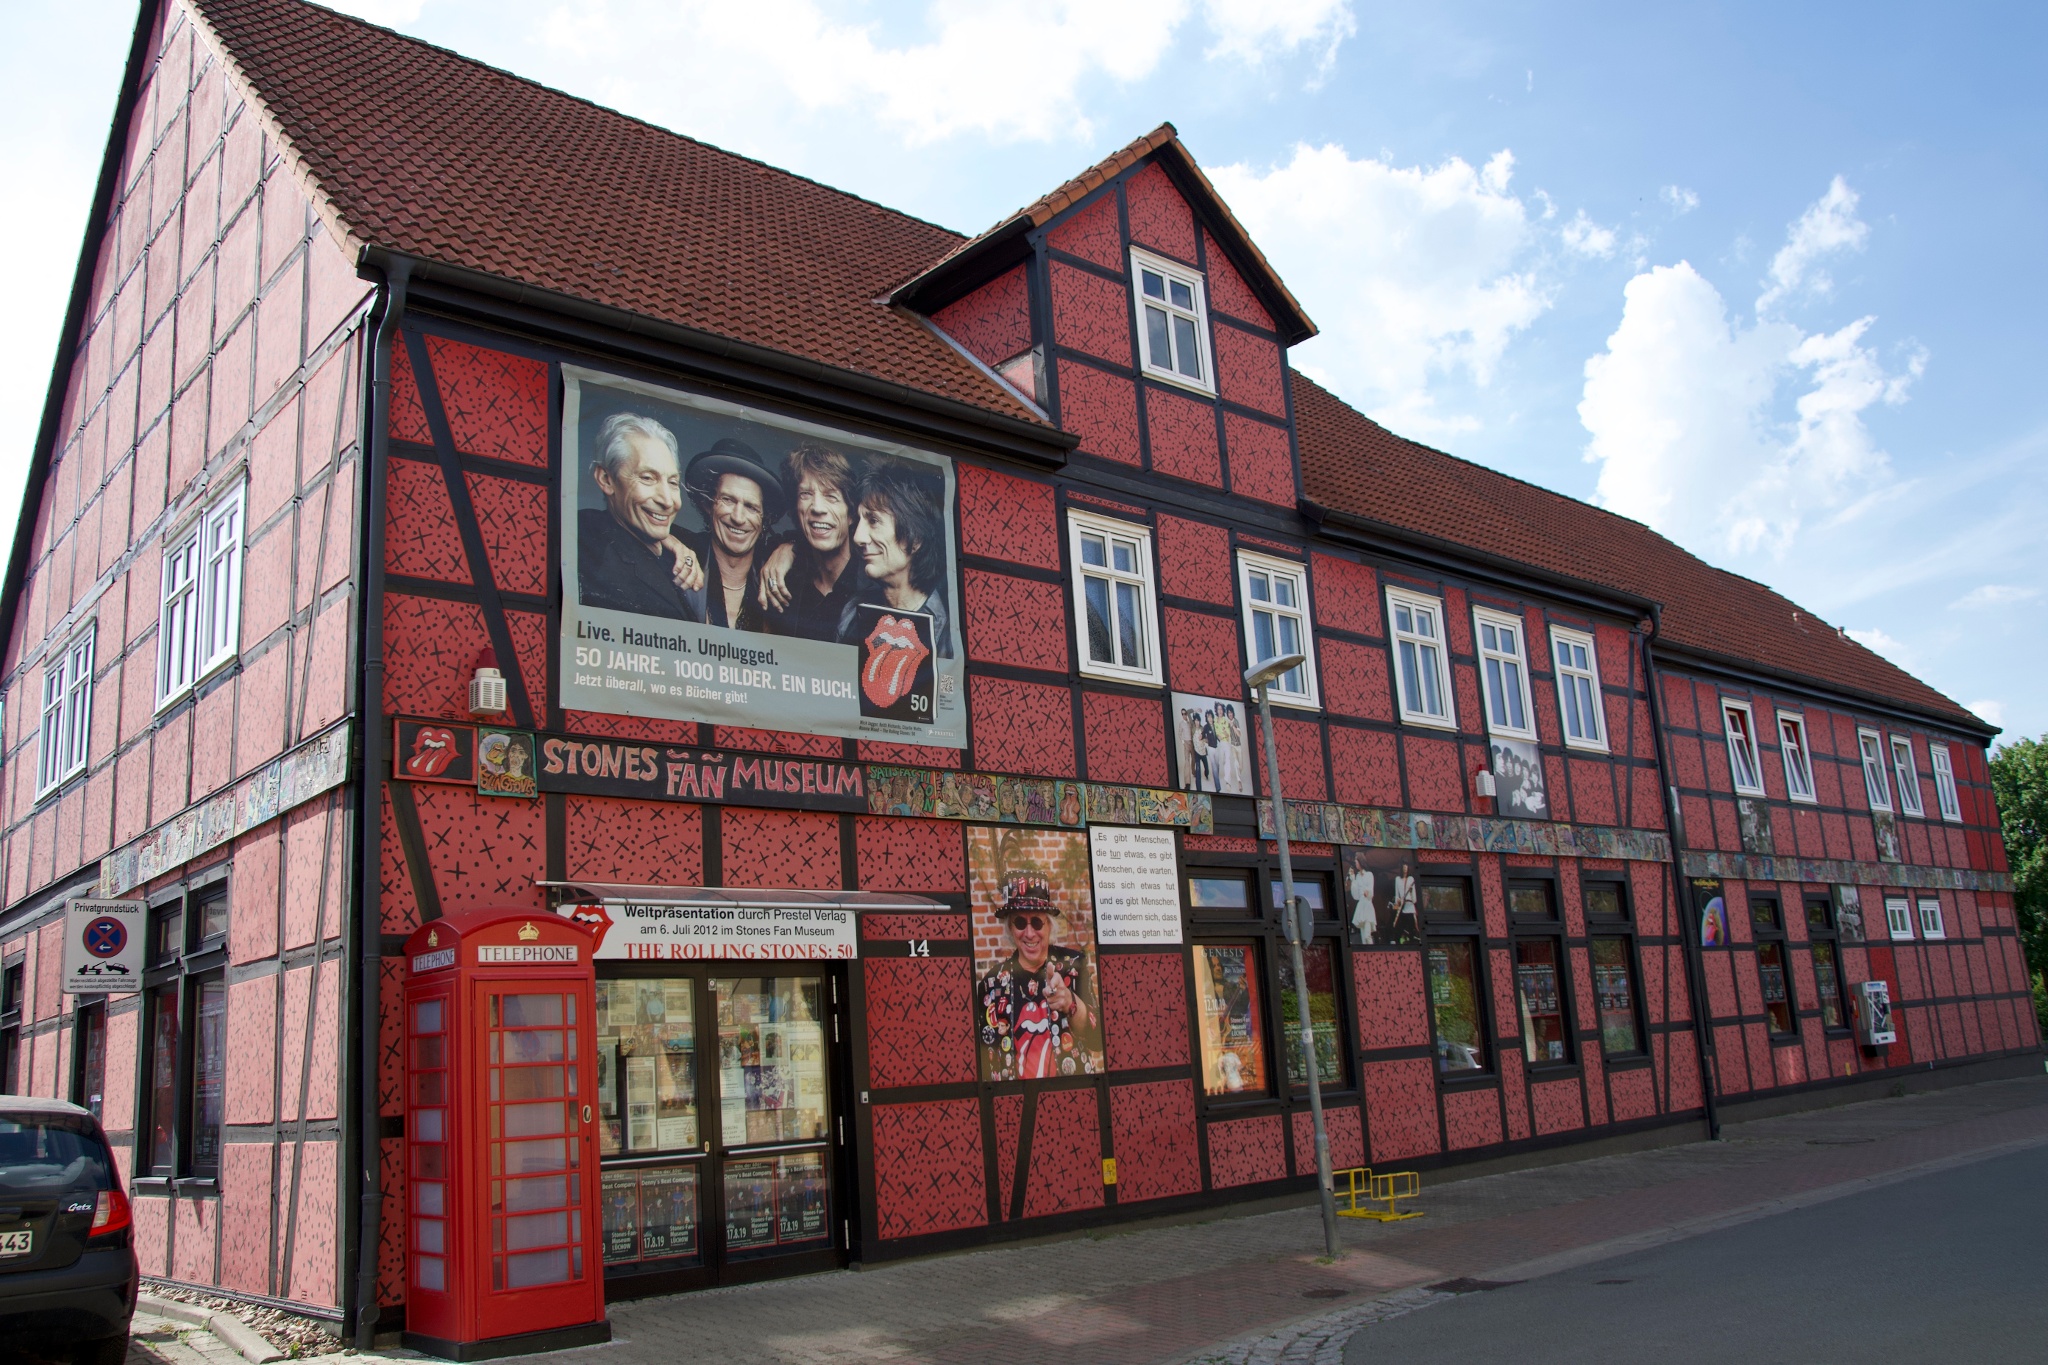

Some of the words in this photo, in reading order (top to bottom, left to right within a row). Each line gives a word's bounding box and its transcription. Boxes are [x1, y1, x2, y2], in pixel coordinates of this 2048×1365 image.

[577, 620, 615, 642] Live.
[622, 627, 691, 653] Hautnah.
[698, 638, 778, 666] Unplugged.
[575, 646, 602, 667] 50
[607, 650, 666, 676] JAHRE.
[673, 659, 714, 681] 1000
[719, 665, 776, 690] BILDER.
[782, 673, 806, 694] EIN
[811, 677, 856, 699] BUCH.
[574, 672, 602, 687] Jetzt
[605, 675, 646, 694] überall,
[650, 683, 666, 694] wo
[669, 685, 682, 696] es
[686, 685, 722, 700] Bücher
[725, 690, 748, 704] gibt!
[910, 694, 929, 712] 50
[543, 737, 659, 781] STONES
[666, 762, 728, 798] FAN
[731, 757, 864, 797] MUSEUM
[1114, 834, 1127, 843] gibt
[1134, 834, 1172, 845] Menschen,
[1096, 848, 1106, 857] die
[1110, 849, 1121, 859] tun
[1124, 850, 1146, 859] etwas,
[1159, 851, 1173, 861] gibt
[1097, 864, 1135, 874] Menschen,
[1136, 866, 1147, 874] die
[1149, 867, 1174, 875] warten,
[1098, 880, 1115, 889] dass
[1121, 881, 1135, 889] sich
[1140, 882, 1160, 890] etwas
[1165, 882, 1175, 890] tut
[1099, 896, 1112, 905] und
[1125, 897, 1139, 907] gibt
[1141, 897, 1177, 907] Menschen,
[74, 902, 139, 914] Privatgrundstück
[624, 905, 734, 920] Weltpräsentation
[738, 908, 770, 920] durch
[774, 909, 812, 920] Prestel
[814, 909, 846, 923] Verlag
[1101, 912, 1111, 920] die
[1113, 912, 1143, 921] wundern
[1144, 913, 1160, 922] sich,
[1161, 913, 1178, 921] dass
[640, 926, 657, 935] am
[660, 924, 669, 934] 6.
[672, 924, 690, 935] Juli
[693, 925, 718, 935] 2012
[721, 925, 733, 935] im
[736, 925, 770, 935] Stones
[774, 925, 792, 936] Fan
[794, 926, 835, 936] Museum
[1102, 928, 1116, 937] sich
[1119, 929, 1139, 937] etwas
[1141, 929, 1161, 938] getan
[481, 947, 574, 961] TELEPHONE
[624, 943, 664, 959] THE
[670, 943, 755, 959] ROLLING
[760, 943, 832, 959] STONES:
[837, 943, 853, 959] 50
[908, 939, 930, 957] 14
[1201, 948, 1244, 957] GENESIS
[414, 949, 454, 971] TELEPHONE
[672, 1176, 694, 1184] Company
[67, 1203, 92, 1212] Getz
[780, 1220, 799, 1232] 17.8.19
[726, 1227, 746, 1239] 17.8.19
[643, 1236, 665, 1248] 17.8.19
